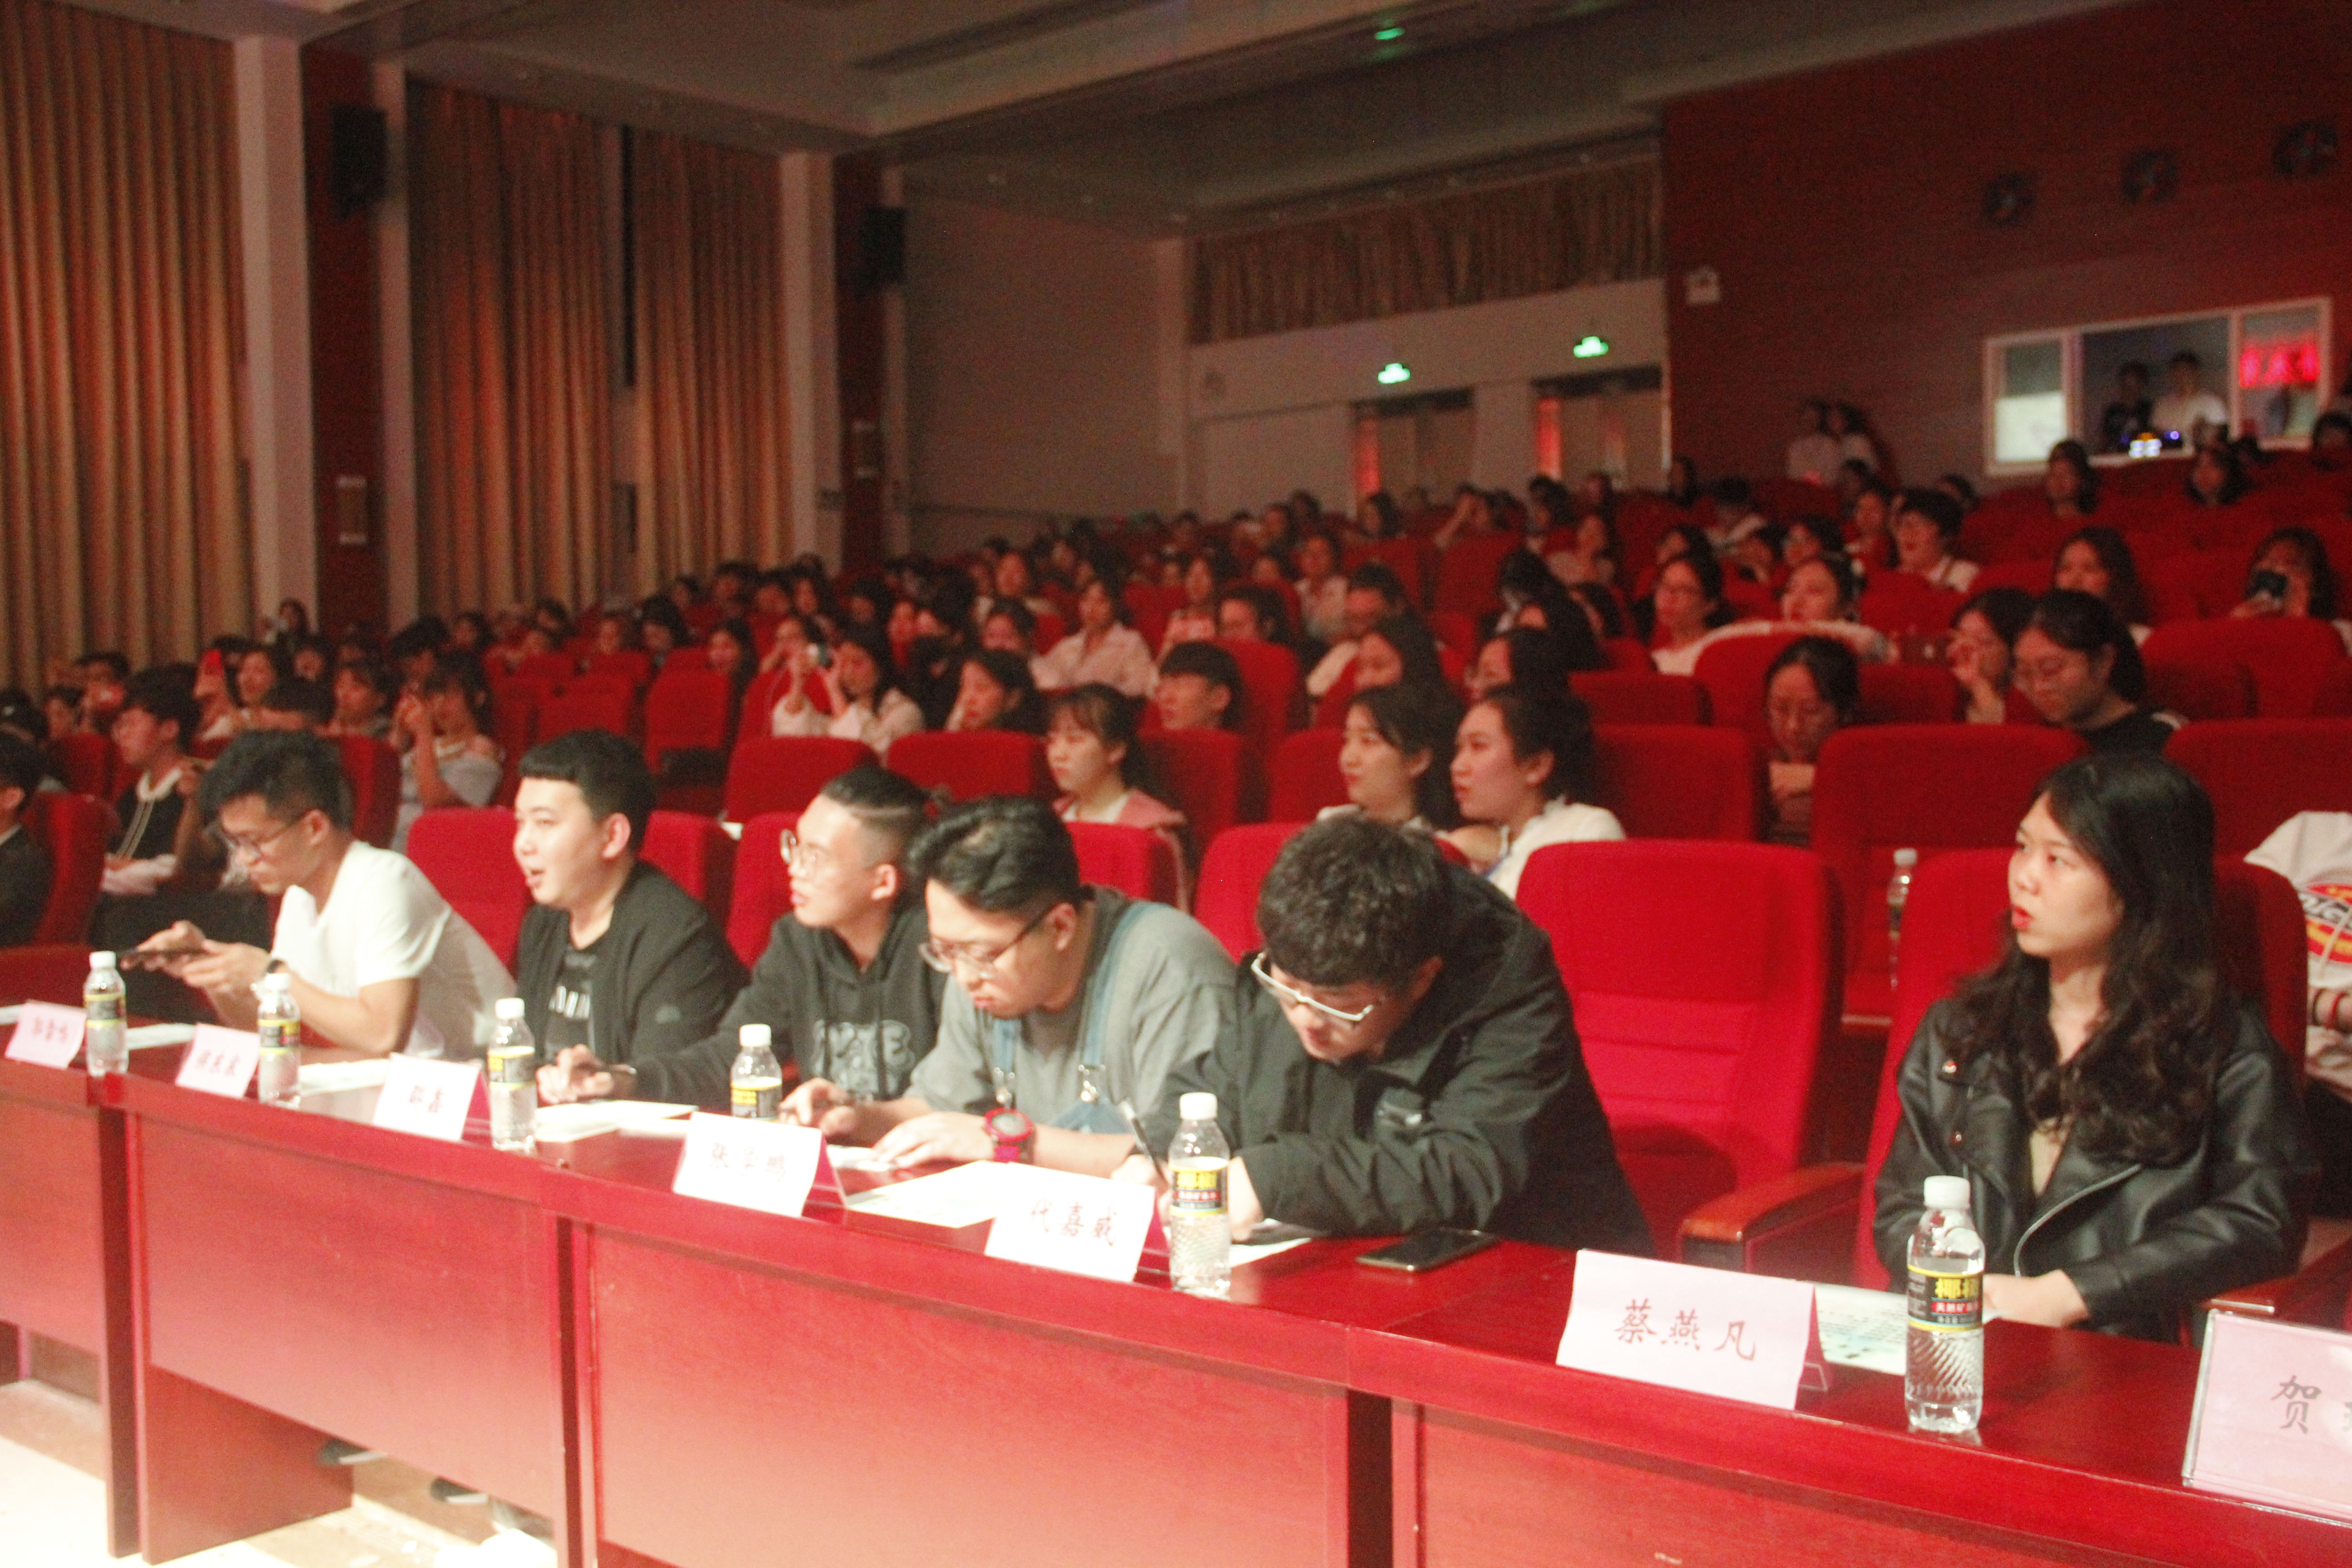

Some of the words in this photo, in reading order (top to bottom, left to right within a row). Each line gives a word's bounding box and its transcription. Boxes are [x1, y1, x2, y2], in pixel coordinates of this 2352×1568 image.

[1614, 1297, 1757, 1361] 蔡燕凡
[2271, 1375, 2352, 1435] 贺
